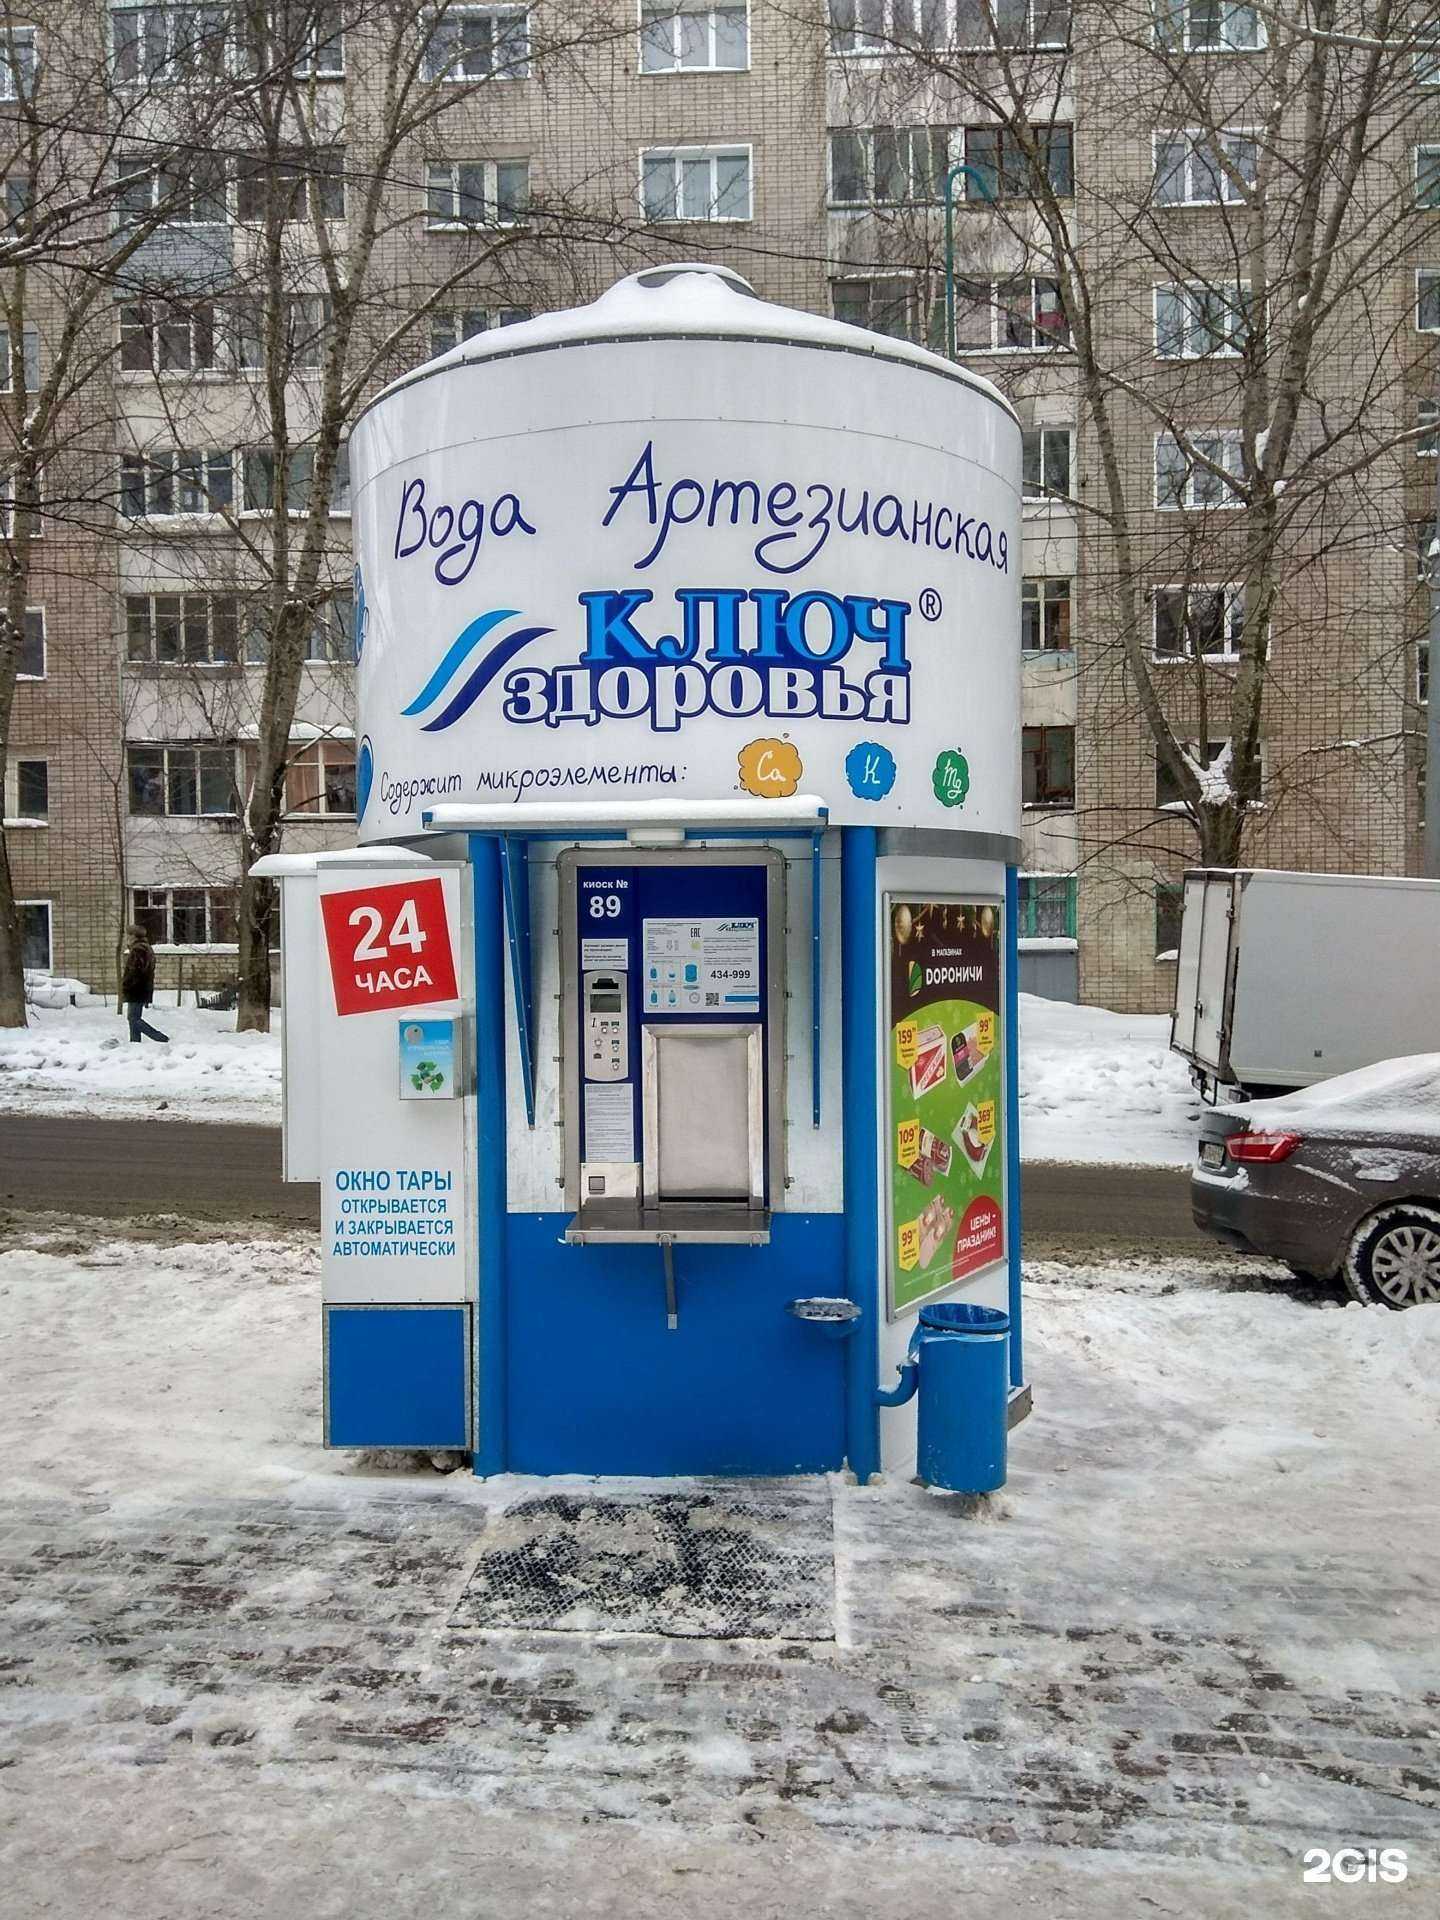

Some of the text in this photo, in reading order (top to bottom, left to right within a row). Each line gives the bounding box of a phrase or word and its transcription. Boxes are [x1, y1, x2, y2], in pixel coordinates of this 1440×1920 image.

[394, 440, 1010, 586] Вода Артезианская
[380, 764, 688, 815] Содержит микроэлементы:
[616, 879, 629, 889] №
[589, 895, 621, 918] 89
[348, 899, 427, 962] 24
[354, 965, 434, 994] ЧАСА
[710, 970, 751, 979] 434-999
[336, 1170, 451, 1191] ОКНО ТАРЫ
[341, 1199, 447, 1214] ОТКРЫВАЕТСЯ
[335, 1220, 453, 1235] И ЗАКРЫВАЕТСЯ
[970, 1212, 991, 1231] ЦЕНЫ
[333, 1241, 456, 1256] АВТОМАТИЧЕСКИ
